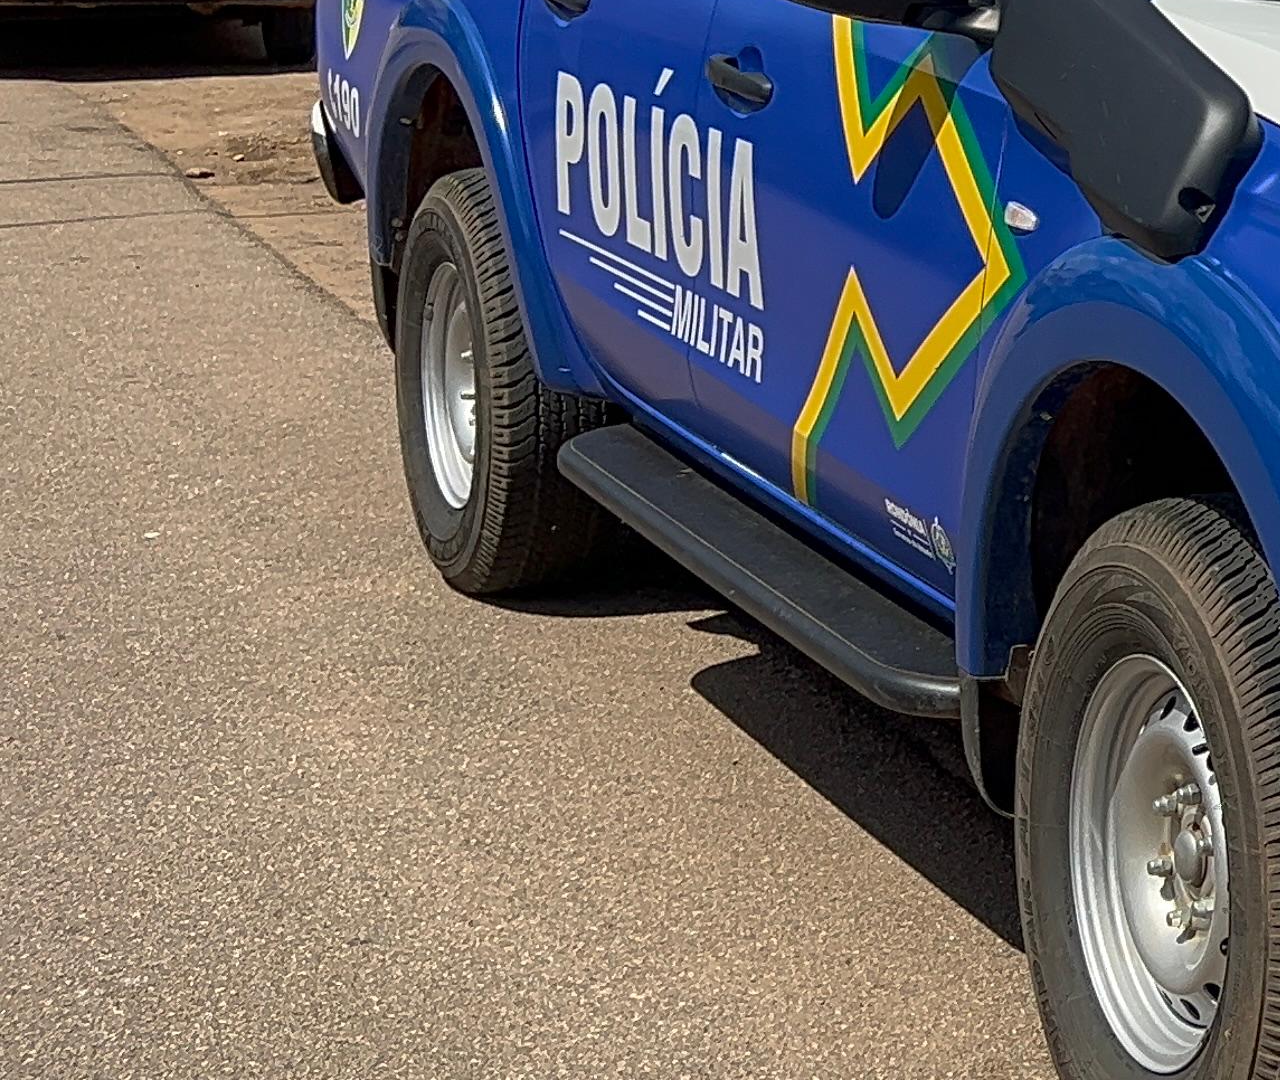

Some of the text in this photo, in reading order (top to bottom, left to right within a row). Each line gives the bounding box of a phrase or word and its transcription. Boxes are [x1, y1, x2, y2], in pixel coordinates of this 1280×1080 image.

[333, 73, 360, 139] 190
[555, 67, 765, 311] POLÍCIA
[670, 283, 764, 385] MILITAR
